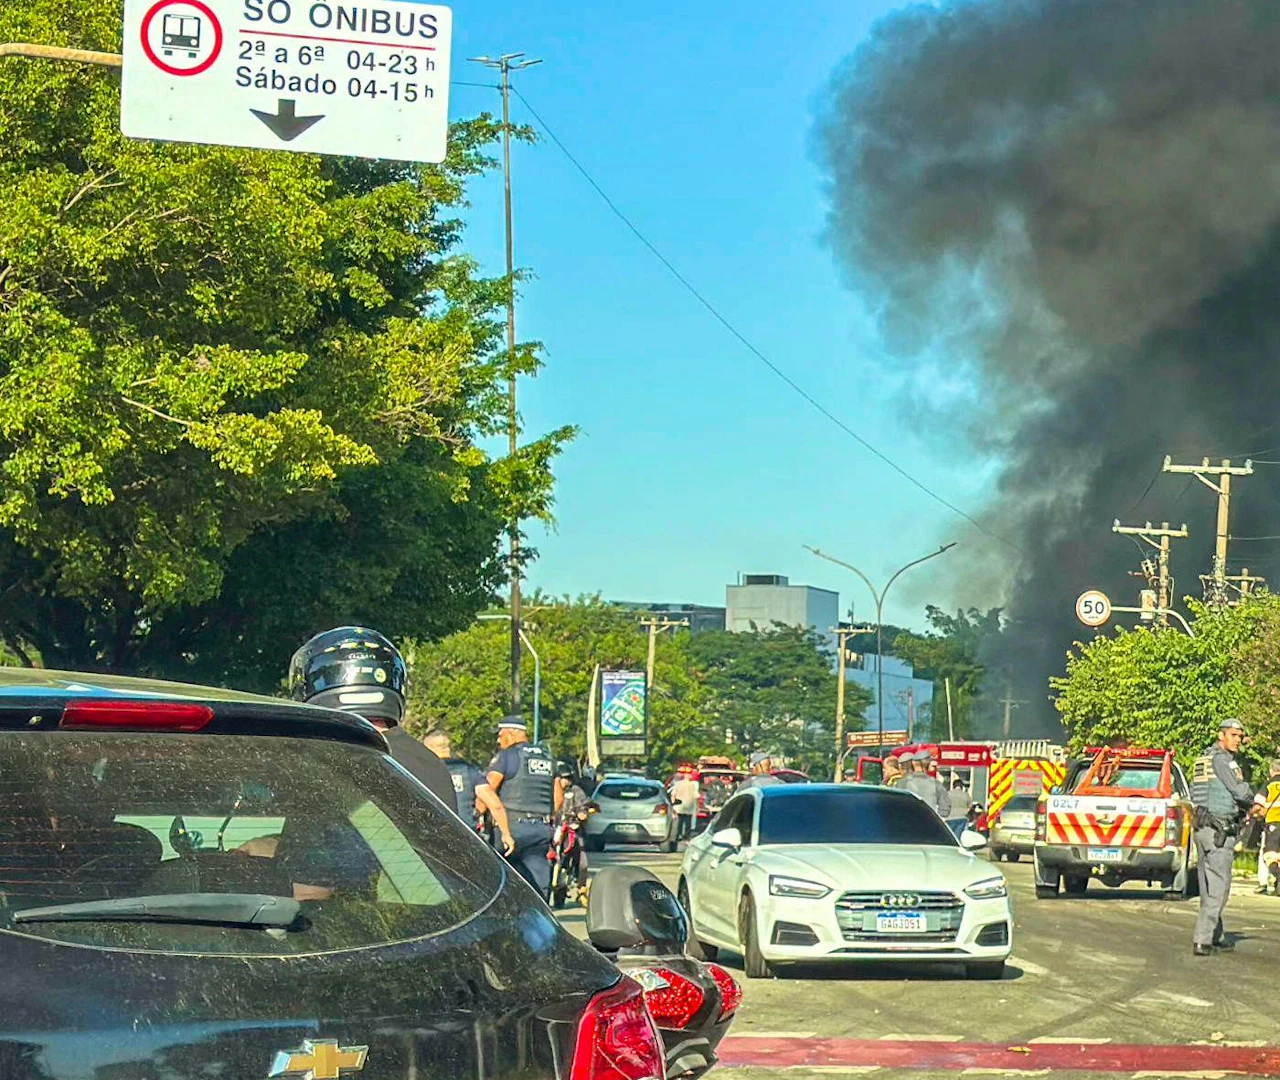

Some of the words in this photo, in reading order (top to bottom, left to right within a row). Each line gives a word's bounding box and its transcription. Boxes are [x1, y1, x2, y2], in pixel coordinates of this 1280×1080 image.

[238, 40, 266, 61] 2ª
[275, 46, 288, 65] a
[298, 45, 325, 66] 6ª
[347, 50, 418, 75] 04-23
[236, 65, 337, 96] Sábado
[348, 77, 417, 102] 04-15
[1084, 601, 1104, 614] 50
